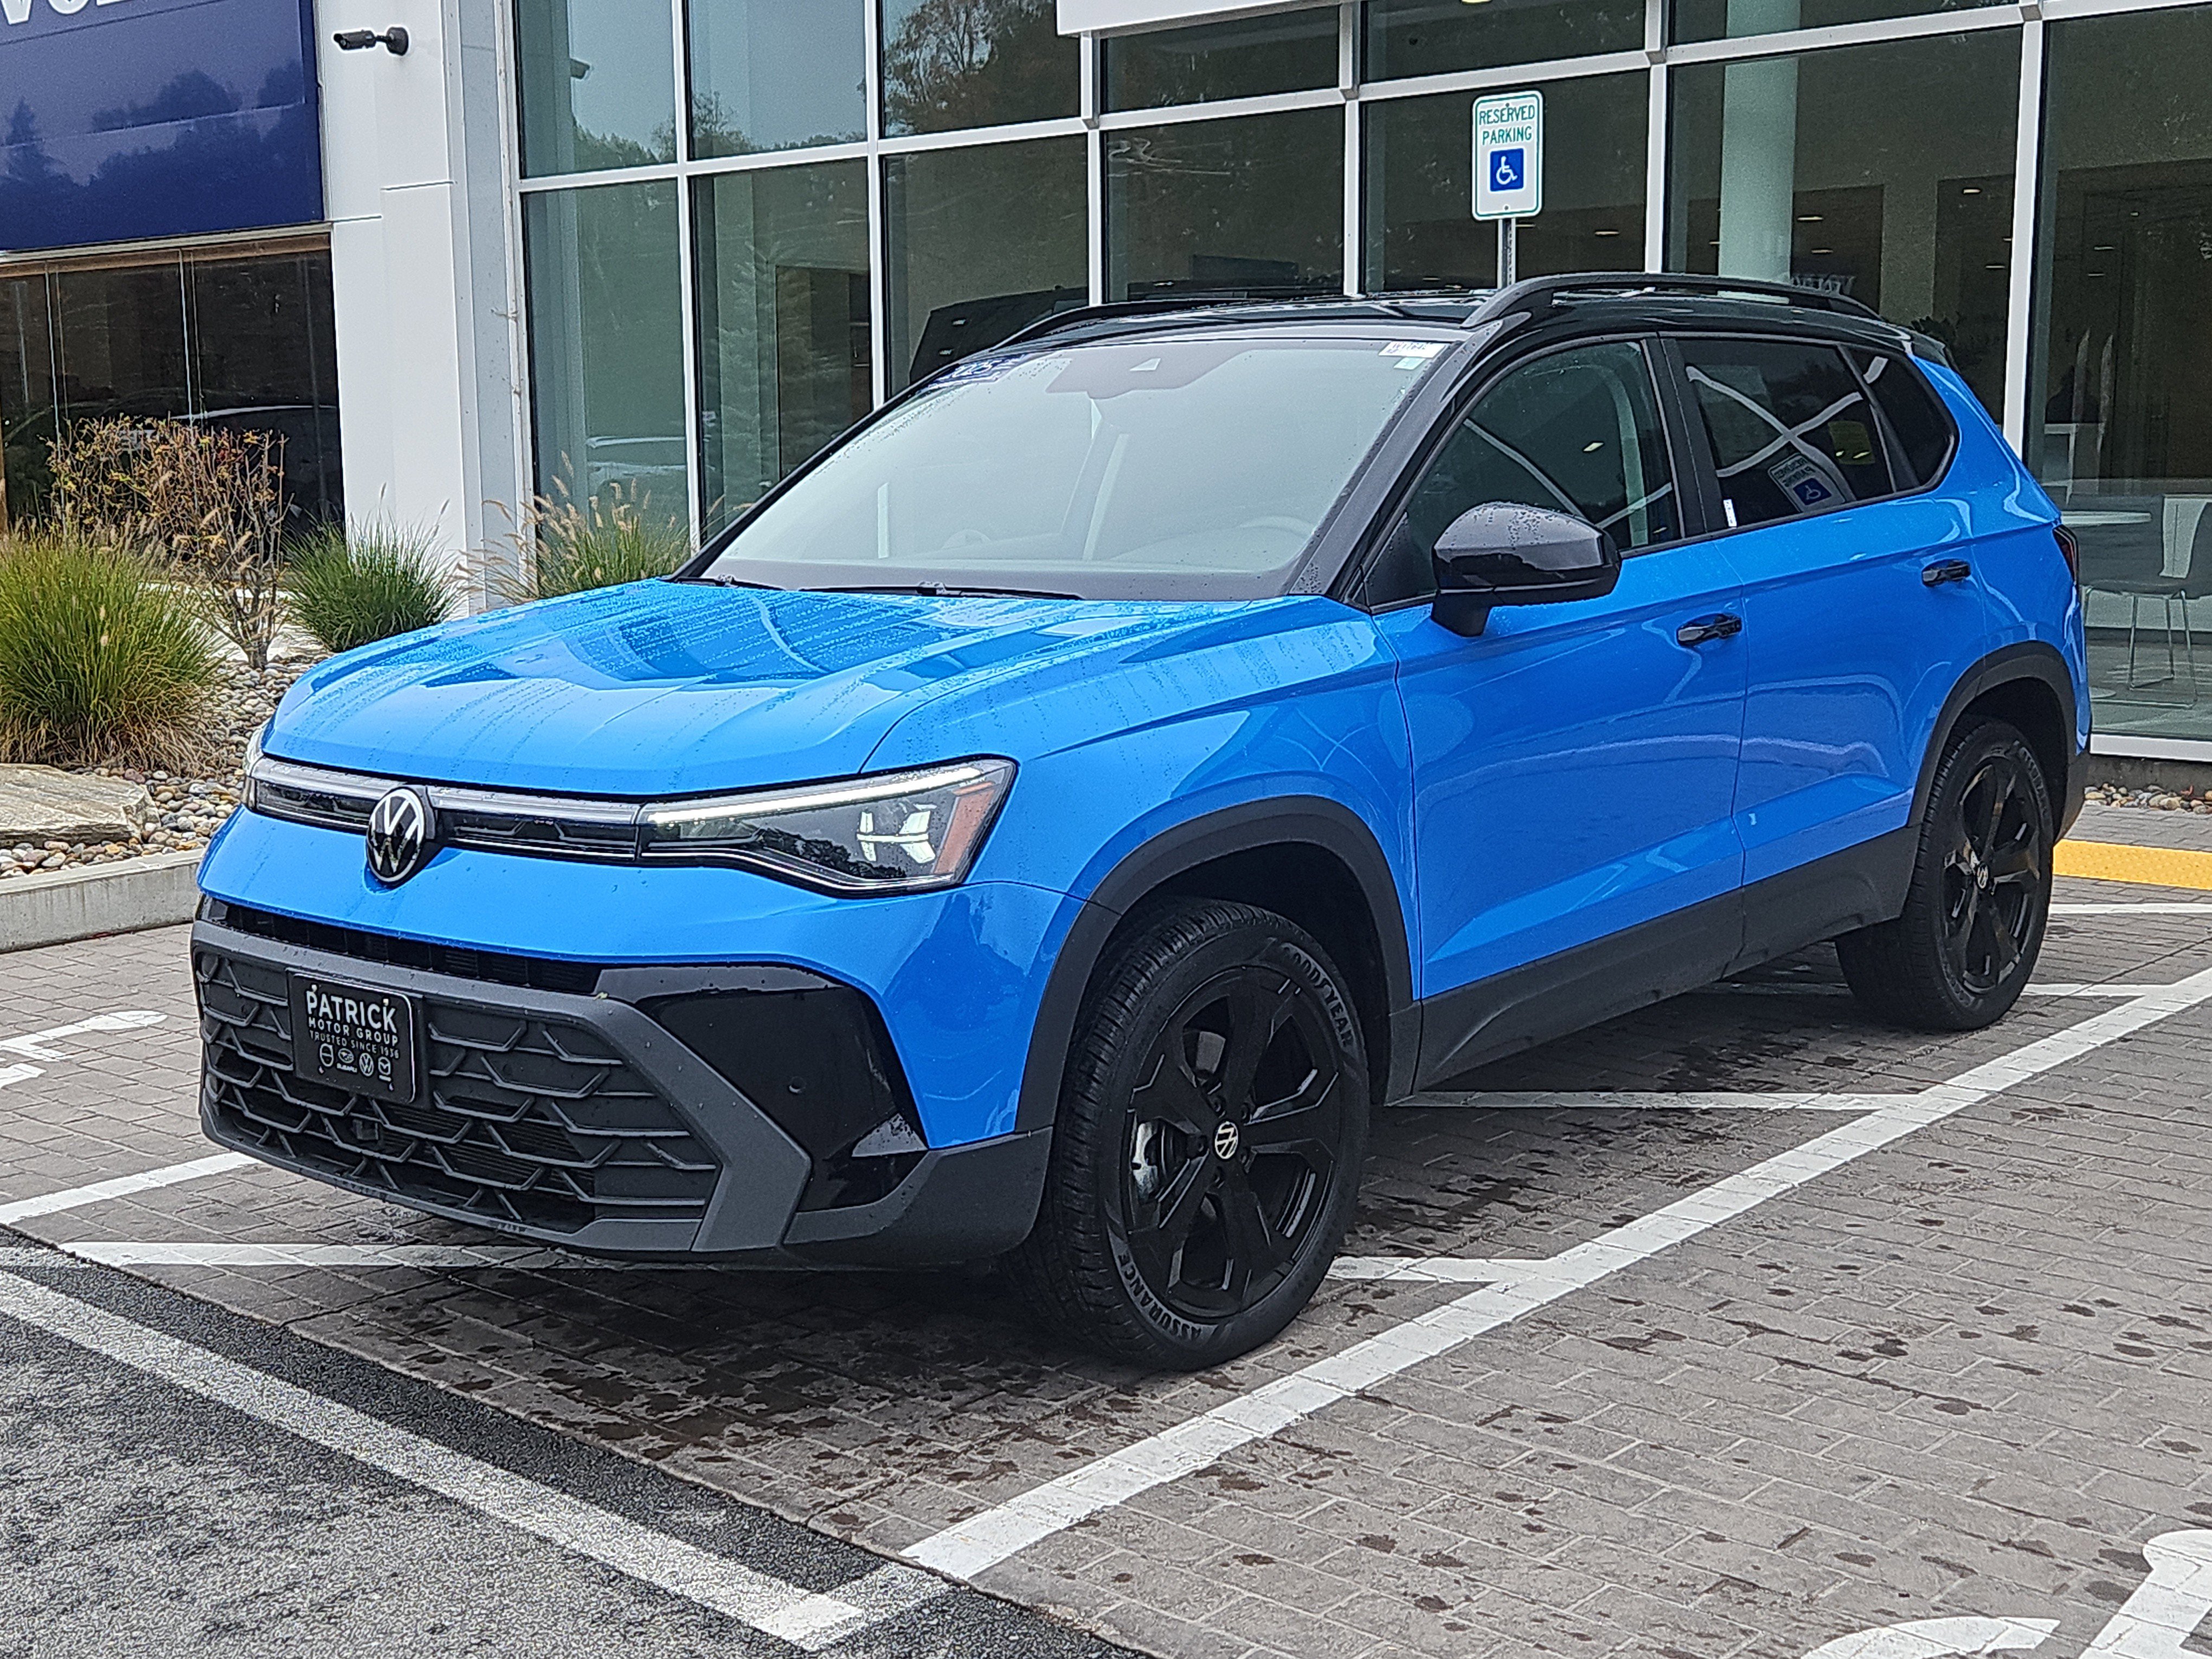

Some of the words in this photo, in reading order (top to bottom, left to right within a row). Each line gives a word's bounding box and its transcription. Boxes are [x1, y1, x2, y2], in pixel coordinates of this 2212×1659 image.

[1479, 105, 1535, 126] RESERVED
[1482, 126, 1532, 145] PARKING
[306, 991, 397, 1033] PATRICK
[308, 1017, 350, 1036] MOTOR
[356, 1028, 398, 1046] GROUP
[310, 1030, 347, 1046] TRUSTED
[351, 1040, 377, 1053] SINCE
[1118, 1253, 1201, 1339] ASSURANCE
